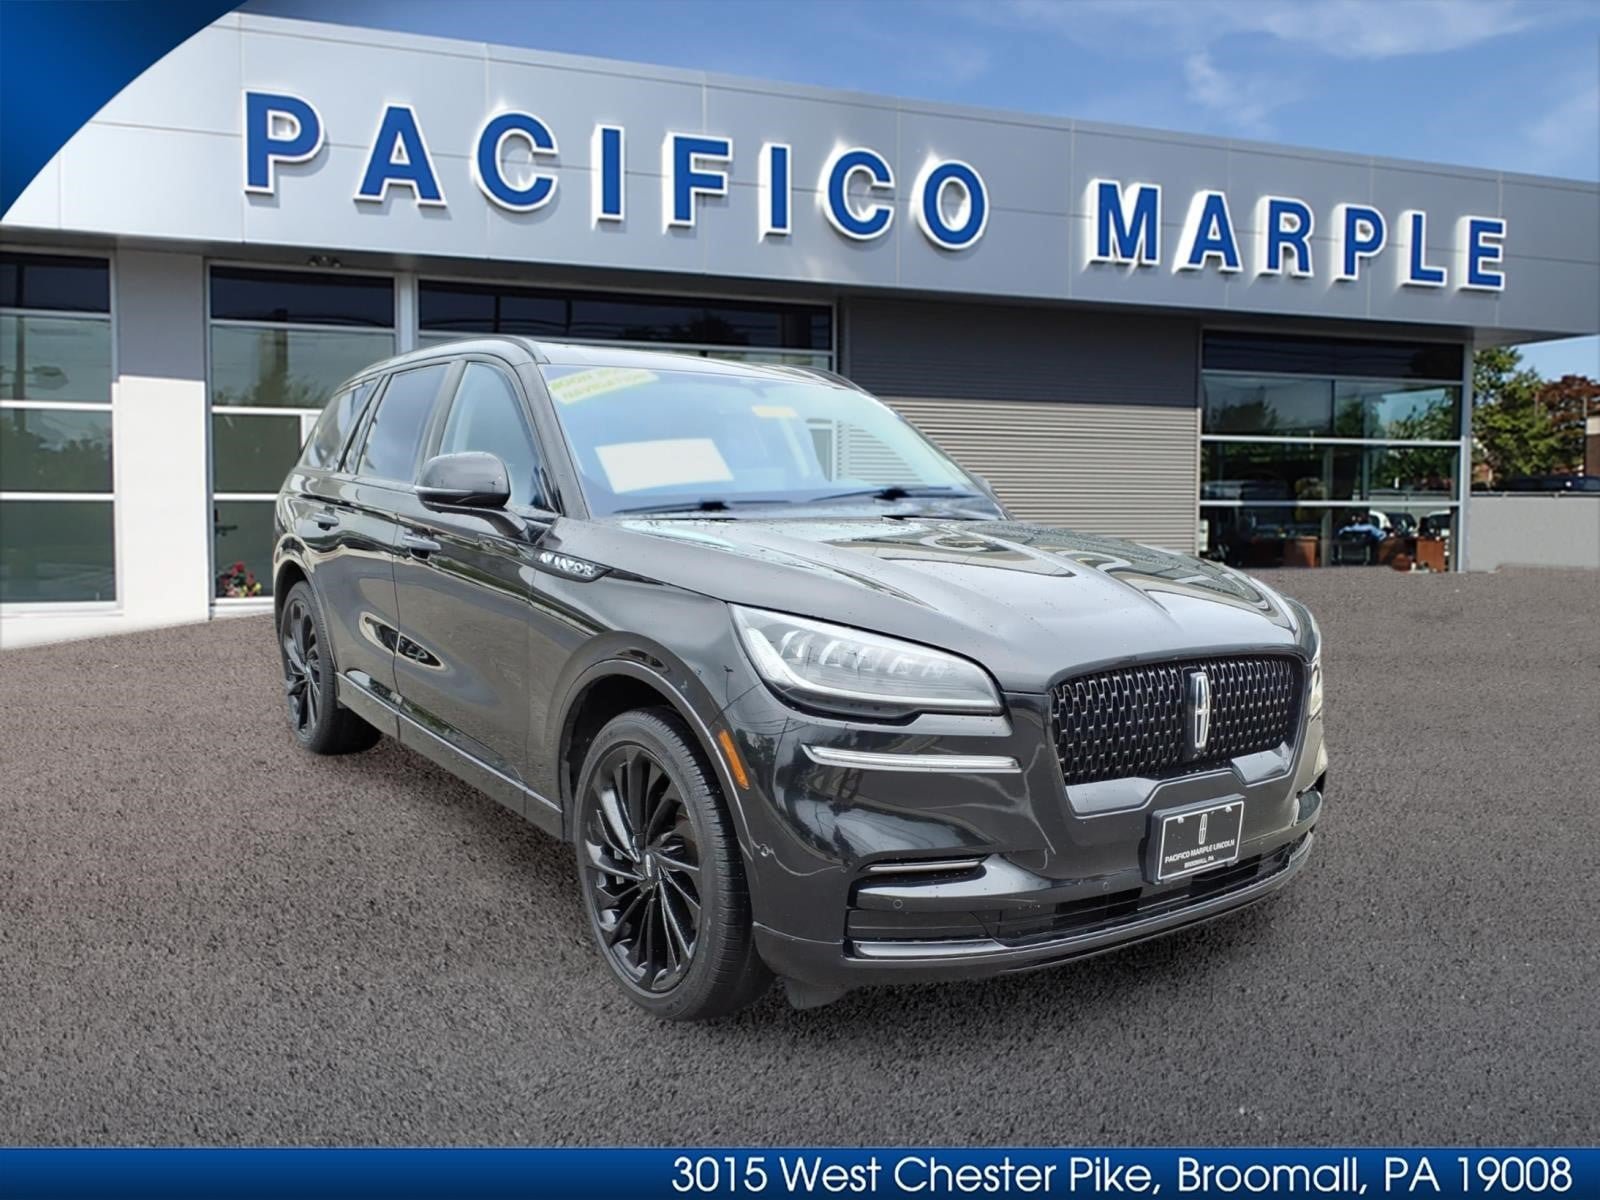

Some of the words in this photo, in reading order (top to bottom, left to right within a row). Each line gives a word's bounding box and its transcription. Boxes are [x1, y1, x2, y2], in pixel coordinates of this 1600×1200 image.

[244, 89, 989, 249] PACIFICO
[1087, 179, 1506, 291] MARPLE
[1165, 850, 1190, 863] PACIFICO
[1191, 844, 1212, 856] MARPLE
[1213, 839, 1235, 851] LINCOLN
